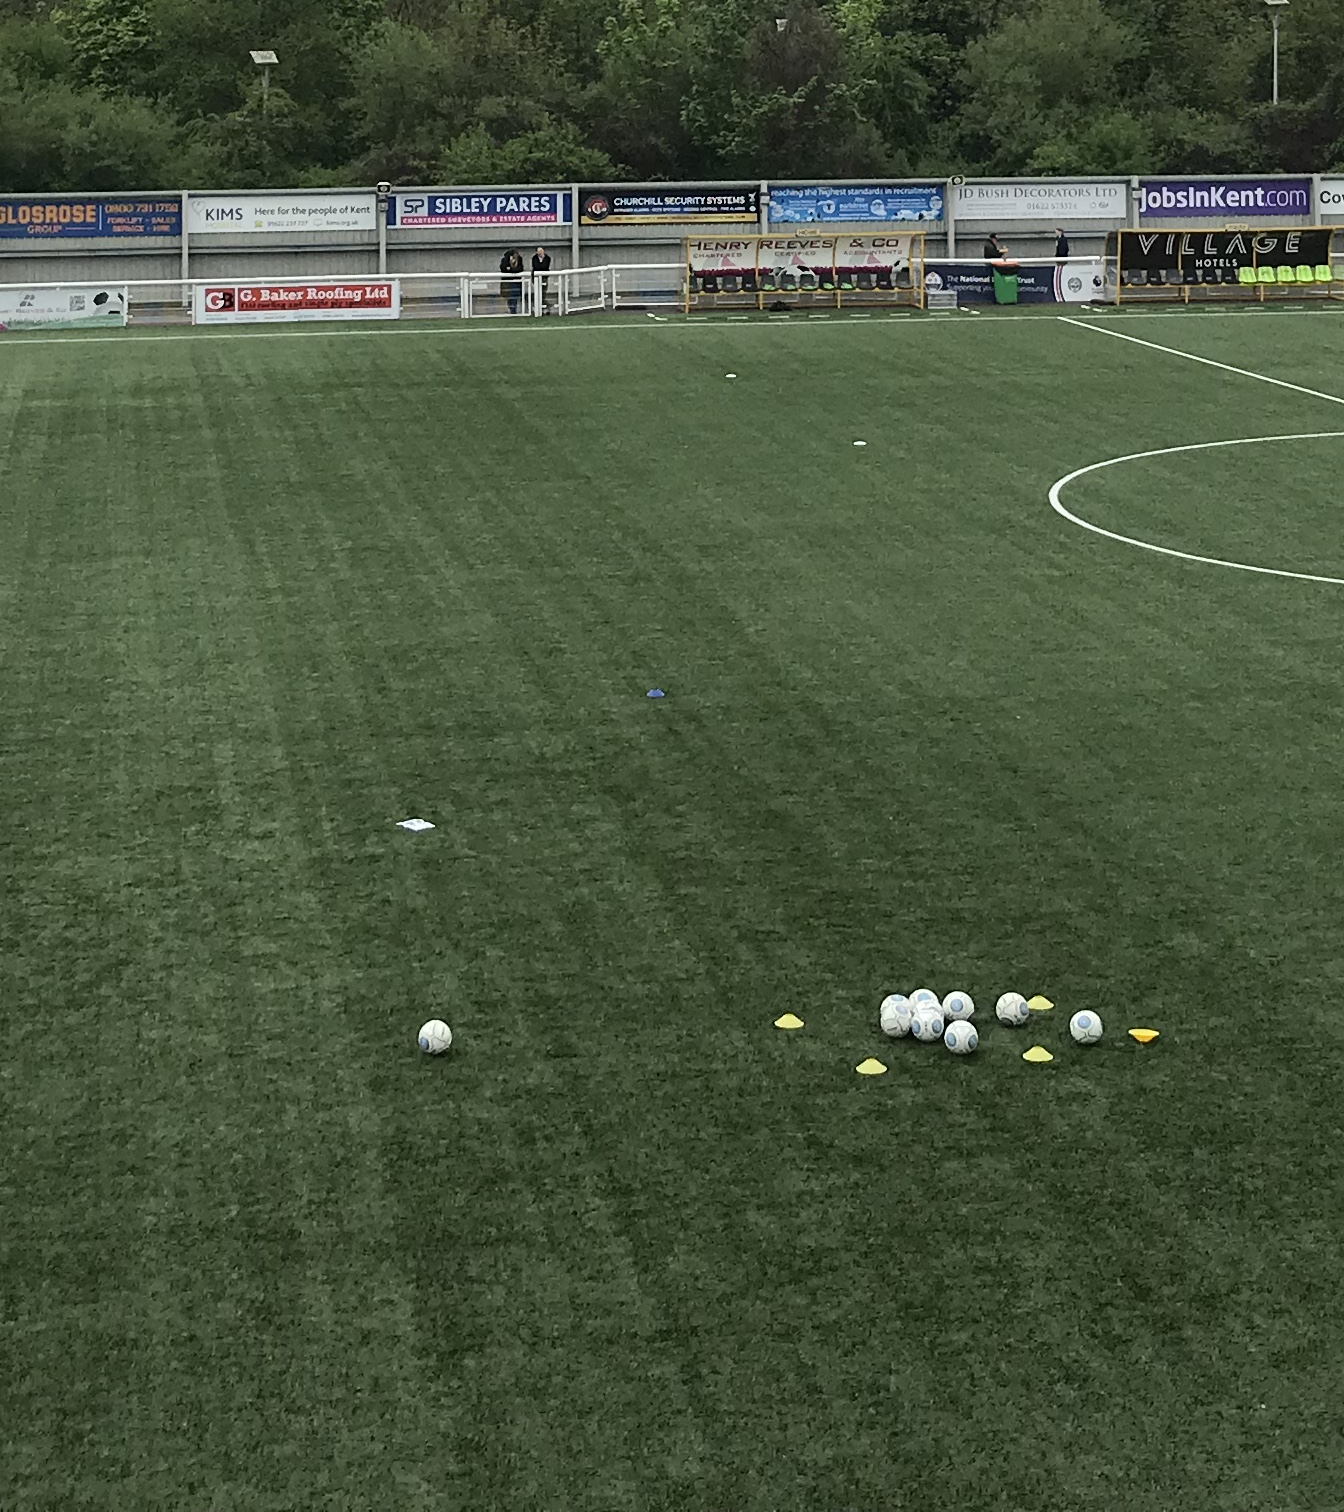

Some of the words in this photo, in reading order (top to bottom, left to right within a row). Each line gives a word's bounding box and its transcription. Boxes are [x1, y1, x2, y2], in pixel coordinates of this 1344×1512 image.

[959, 188, 974, 200] JD
[978, 188, 1009, 199] BUSH
[1014, 186, 1091, 198] DECORATORS
[1095, 186, 1117, 197] LTD
[1140, 186, 1307, 213] JobsInKent.com
[435, 197, 492, 213] SIBLEY
[496, 196, 550, 212] PARES
[614, 196, 663, 206] CHURCHILL
[664, 196, 705, 206] SECURITY
[706, 195, 745, 205] SYSTEMS
[205, 207, 244, 221] KIMS
[254, 207, 276, 216] Here
[277, 207, 290, 216] for
[291, 206, 306, 216] the
[308, 206, 338, 218] people
[339, 205, 349, 215] of
[350, 205, 371, 215] Kent
[402, 216, 447, 225] CHARTERED
[448, 215, 490, 224] SURVEYORS
[491, 215, 498, 223] &
[499, 215, 525, 223] ESTATE
[526, 214, 556, 222] AGENTS
[27, 225, 63, 234] GROUP
[759, 238, 834, 250] REEVES
[849, 238, 864, 248] &
[1138, 232, 1302, 255] VILLAGE
[1195, 258, 1238, 267] HOTELS
[947, 275, 959, 283] The
[959, 275, 990, 284] National
[1017, 276, 1035, 284] Trust
[240, 290, 256, 302] G.
[259, 288, 304, 301] Baker
[306, 287, 363, 302] Roofing
[364, 286, 388, 299] Ltd
